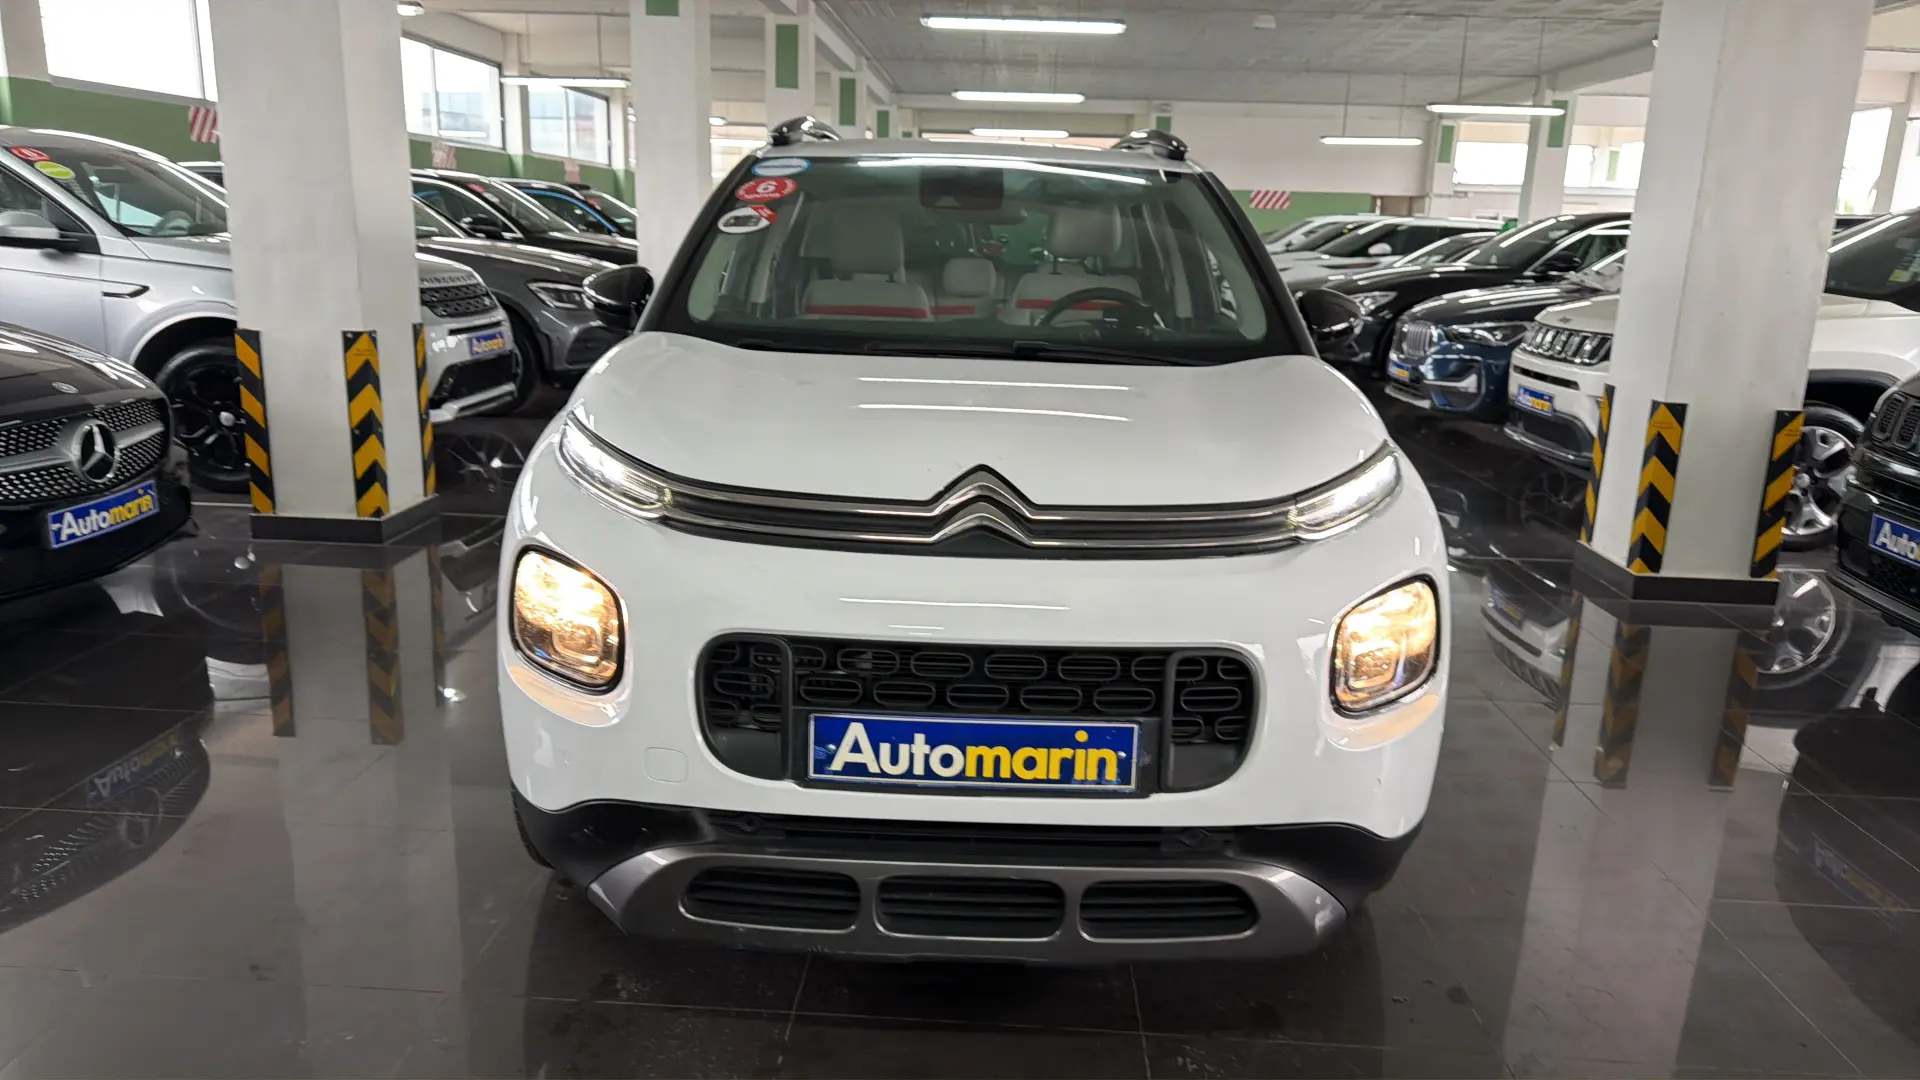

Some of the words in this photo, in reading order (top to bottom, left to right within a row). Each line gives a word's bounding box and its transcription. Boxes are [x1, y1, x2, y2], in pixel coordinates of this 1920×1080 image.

[60, 488, 154, 541] Automarin
[1875, 521, 1920, 561] Auto
[829, 722, 1118, 781] Automarin
